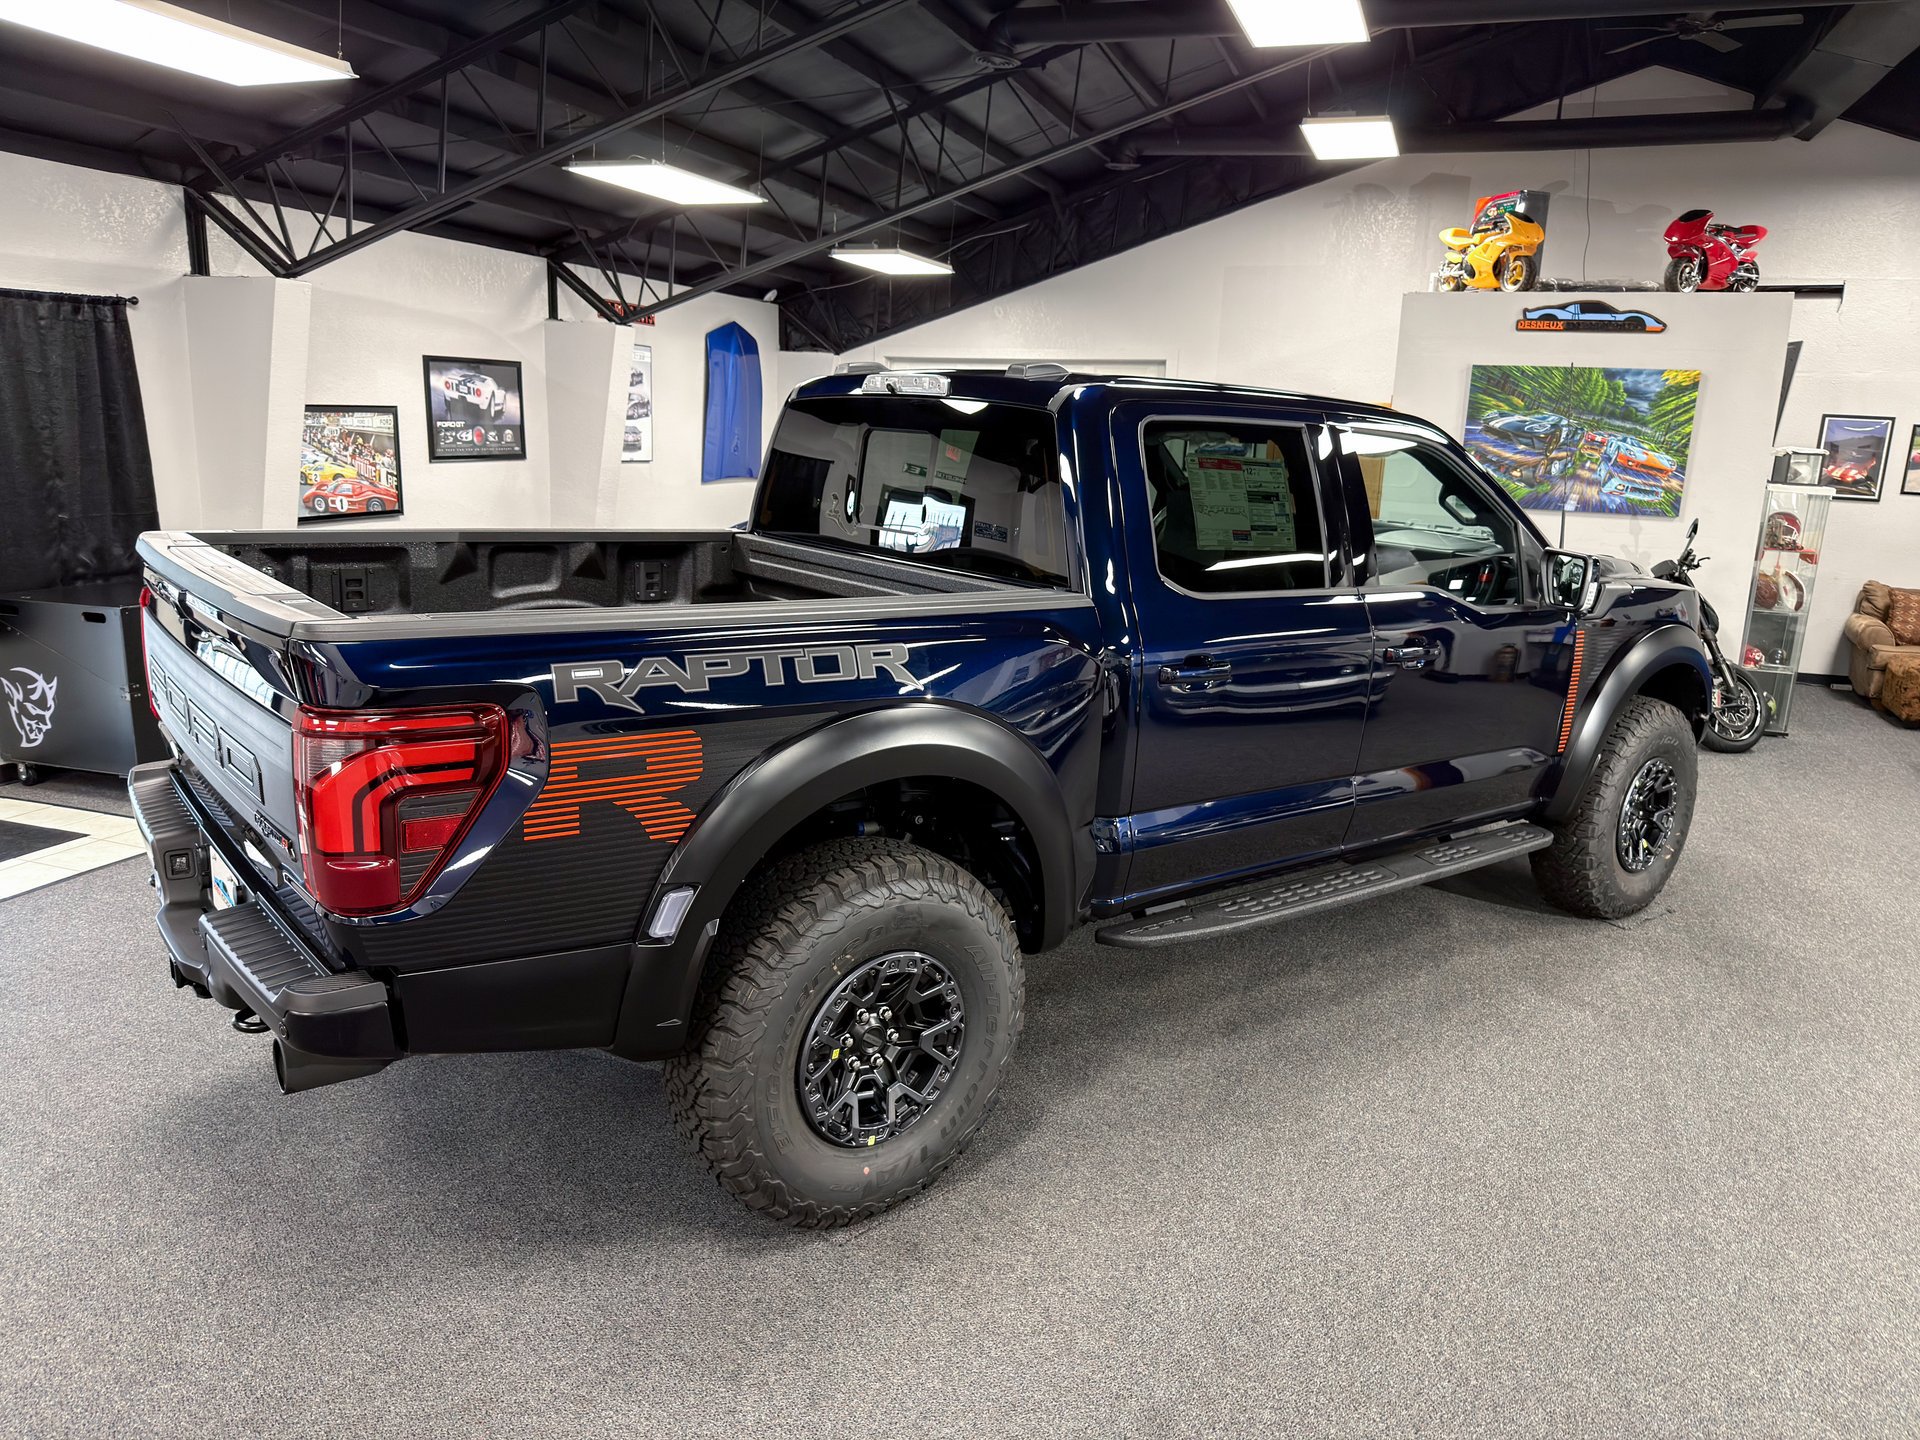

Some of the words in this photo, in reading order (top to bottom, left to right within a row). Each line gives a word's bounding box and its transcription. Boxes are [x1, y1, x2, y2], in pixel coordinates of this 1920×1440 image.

[1518, 320, 1564, 330] DESNEUX
[150, 654, 265, 806] FORD
[550, 643, 924, 714] RAPTOR
[523, 730, 704, 843] R
[940, 944, 1002, 1142] All-Terrain
